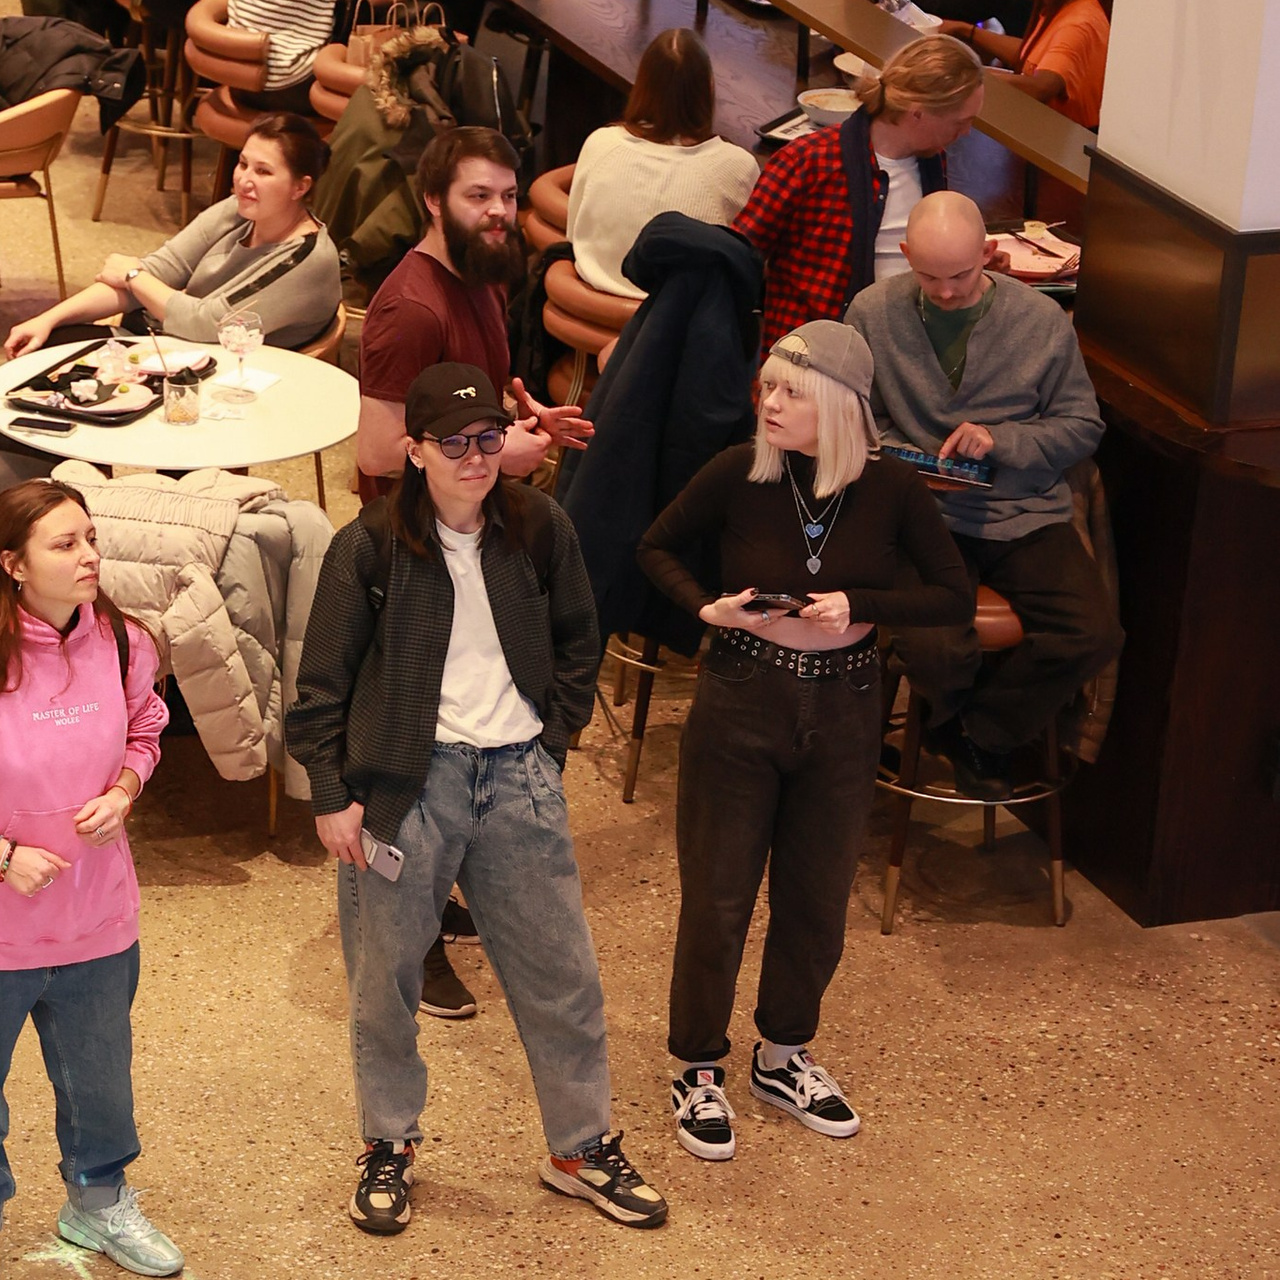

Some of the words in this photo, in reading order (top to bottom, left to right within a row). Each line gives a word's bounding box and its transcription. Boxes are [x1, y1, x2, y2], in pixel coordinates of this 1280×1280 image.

[32, 708, 66, 721] MASTER
[68, 706, 80, 716] OF
[82, 702, 99, 713] LIFE
